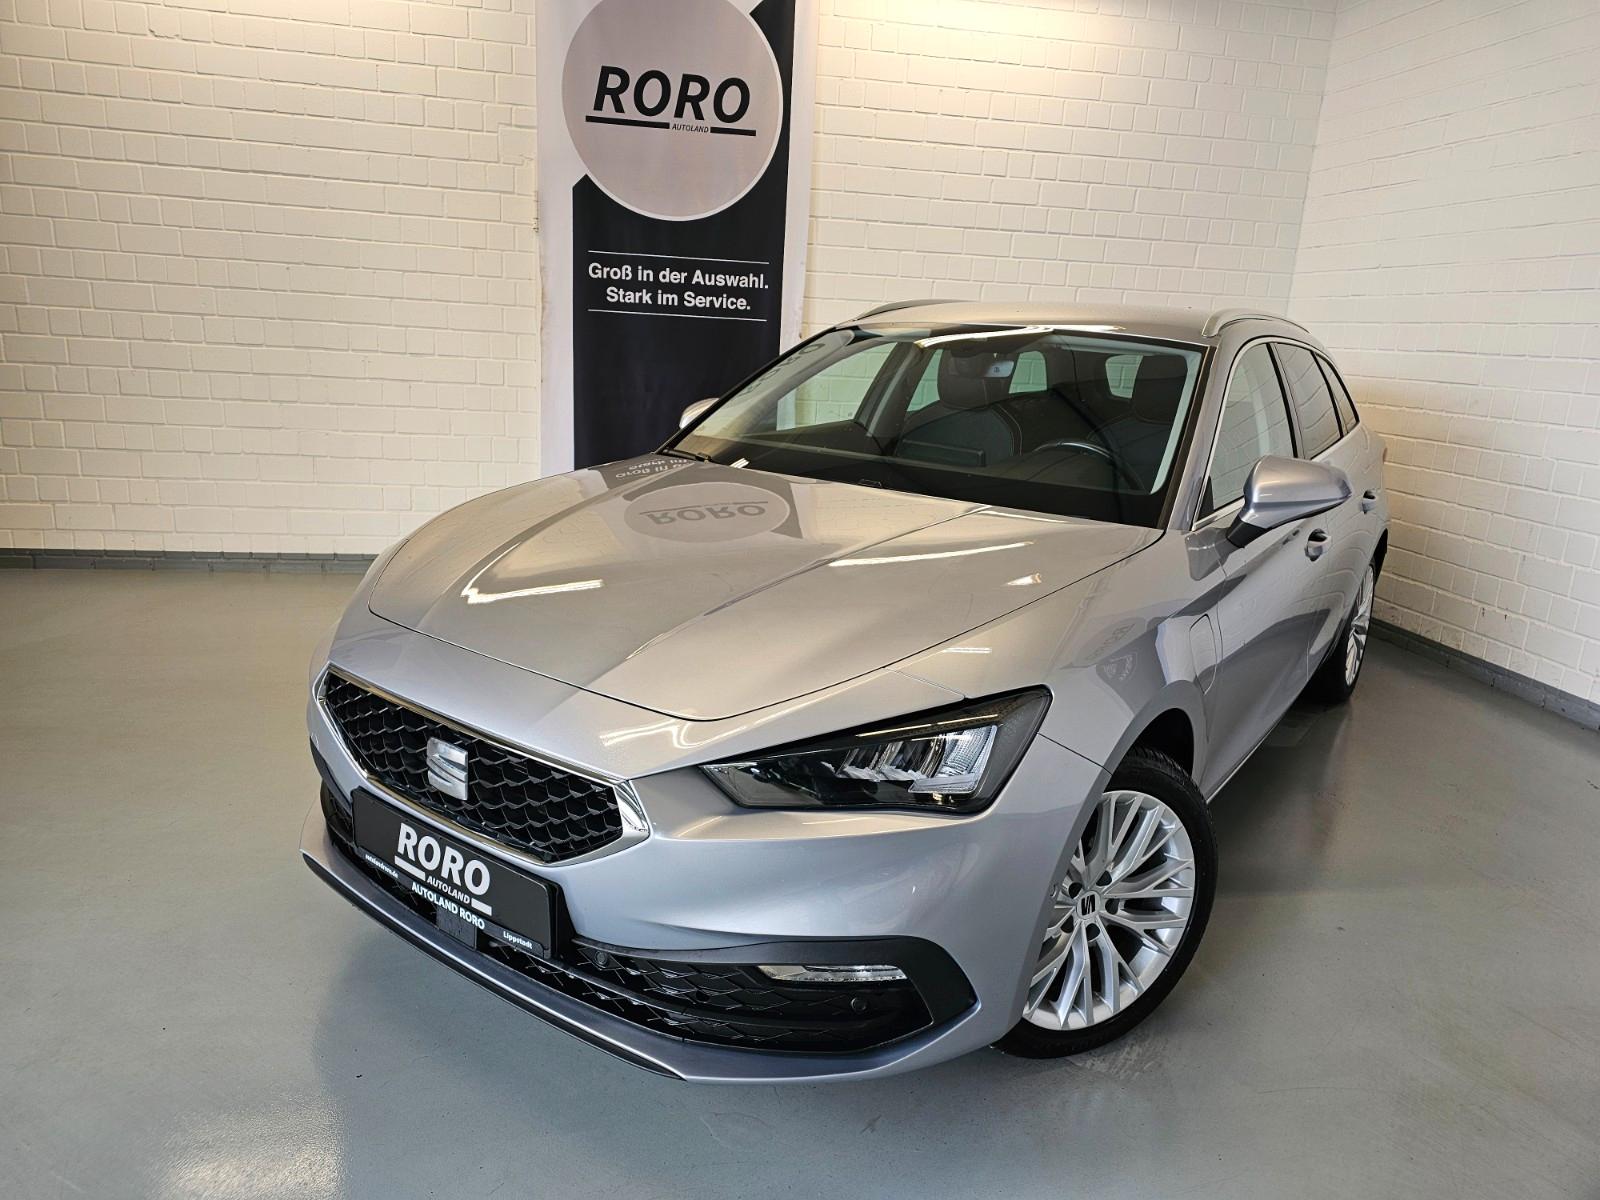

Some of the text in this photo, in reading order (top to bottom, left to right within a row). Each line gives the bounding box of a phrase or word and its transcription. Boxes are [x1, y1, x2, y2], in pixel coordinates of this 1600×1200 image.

[592, 65, 750, 124] RORO
[671, 122, 709, 134] AUTOLAND
[588, 262, 769, 289] Groß in der Auswahl.
[606, 286, 751, 311] Stark im Service.
[397, 822, 491, 896] RORO
[426, 875, 471, 905] AUTOLAND
[411, 881, 485, 930] AUTOLAND RORO
[503, 930, 533, 950] Lippstadt
